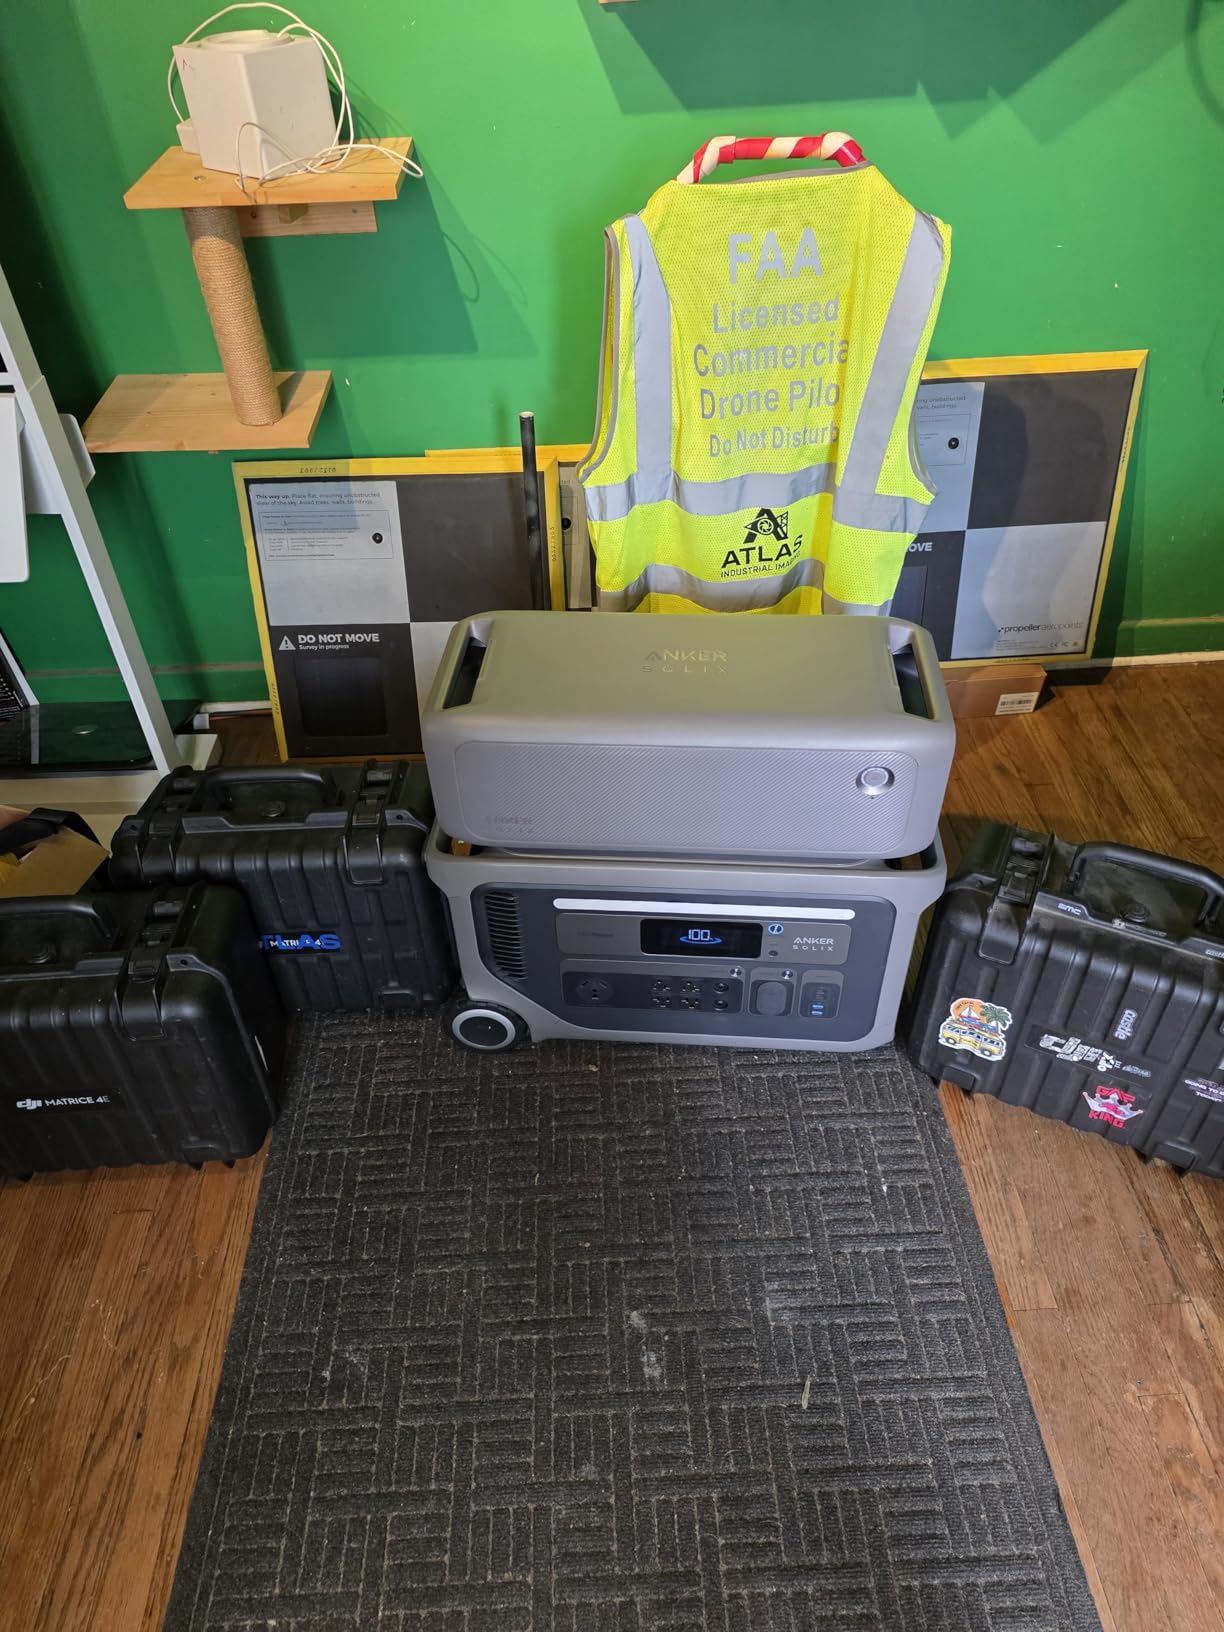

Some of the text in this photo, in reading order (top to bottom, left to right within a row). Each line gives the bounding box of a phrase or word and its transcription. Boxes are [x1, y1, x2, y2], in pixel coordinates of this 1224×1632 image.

[729, 227, 823, 285] FAA
[712, 291, 840, 334] Licensed
[693, 331, 850, 377] Commercia
[700, 377, 840, 420] Drone Pilo
[709, 420, 839, 458] Do Not Disturb
[721, 534, 803, 569] ATLAS
[908, 542, 933, 552] OVE
[721, 564, 773, 578] INDUSTRIAL
[1004, 623, 1041, 634] propeller
[298, 632, 380, 644] DO NOT MOVE
[644, 648, 728, 661] ANKER
[262, 934, 342, 950] TLAS
[793, 937, 834, 945] ANKER
[16, 1098, 43, 1110] dji
[44, 1096, 95, 1106] MATRICE
[1088, 1110, 1126, 1129] KING
